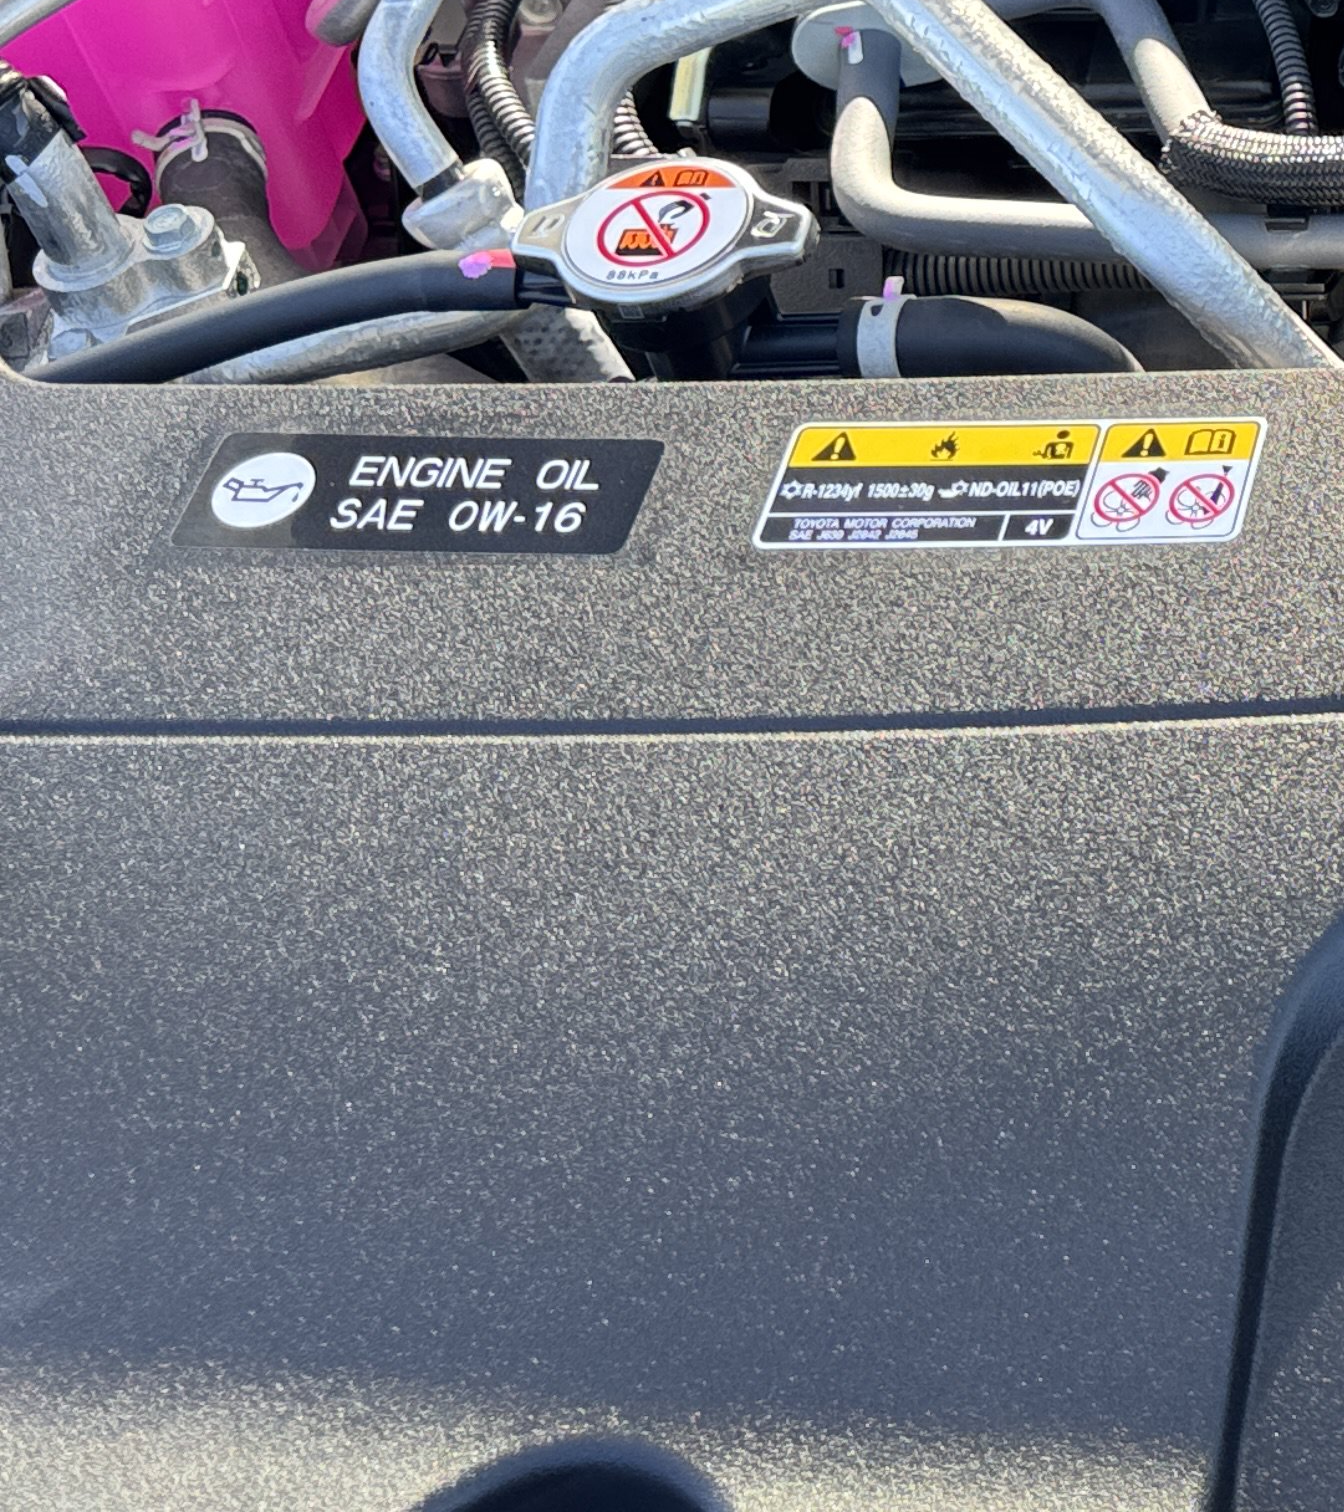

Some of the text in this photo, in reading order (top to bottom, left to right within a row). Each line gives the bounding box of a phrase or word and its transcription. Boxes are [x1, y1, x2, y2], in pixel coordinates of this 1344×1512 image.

[349, 455, 600, 491] ENGINE OIL
[801, 479, 1081, 502] R-1234yf 1500±30g ND-OIL11(POE)
[329, 498, 425, 531] SAE
[793, 517, 977, 529] TOYOTA MOTOR CORPORATION
[788, 530, 813, 540] SAE
[1024, 518, 1054, 535] 4V
